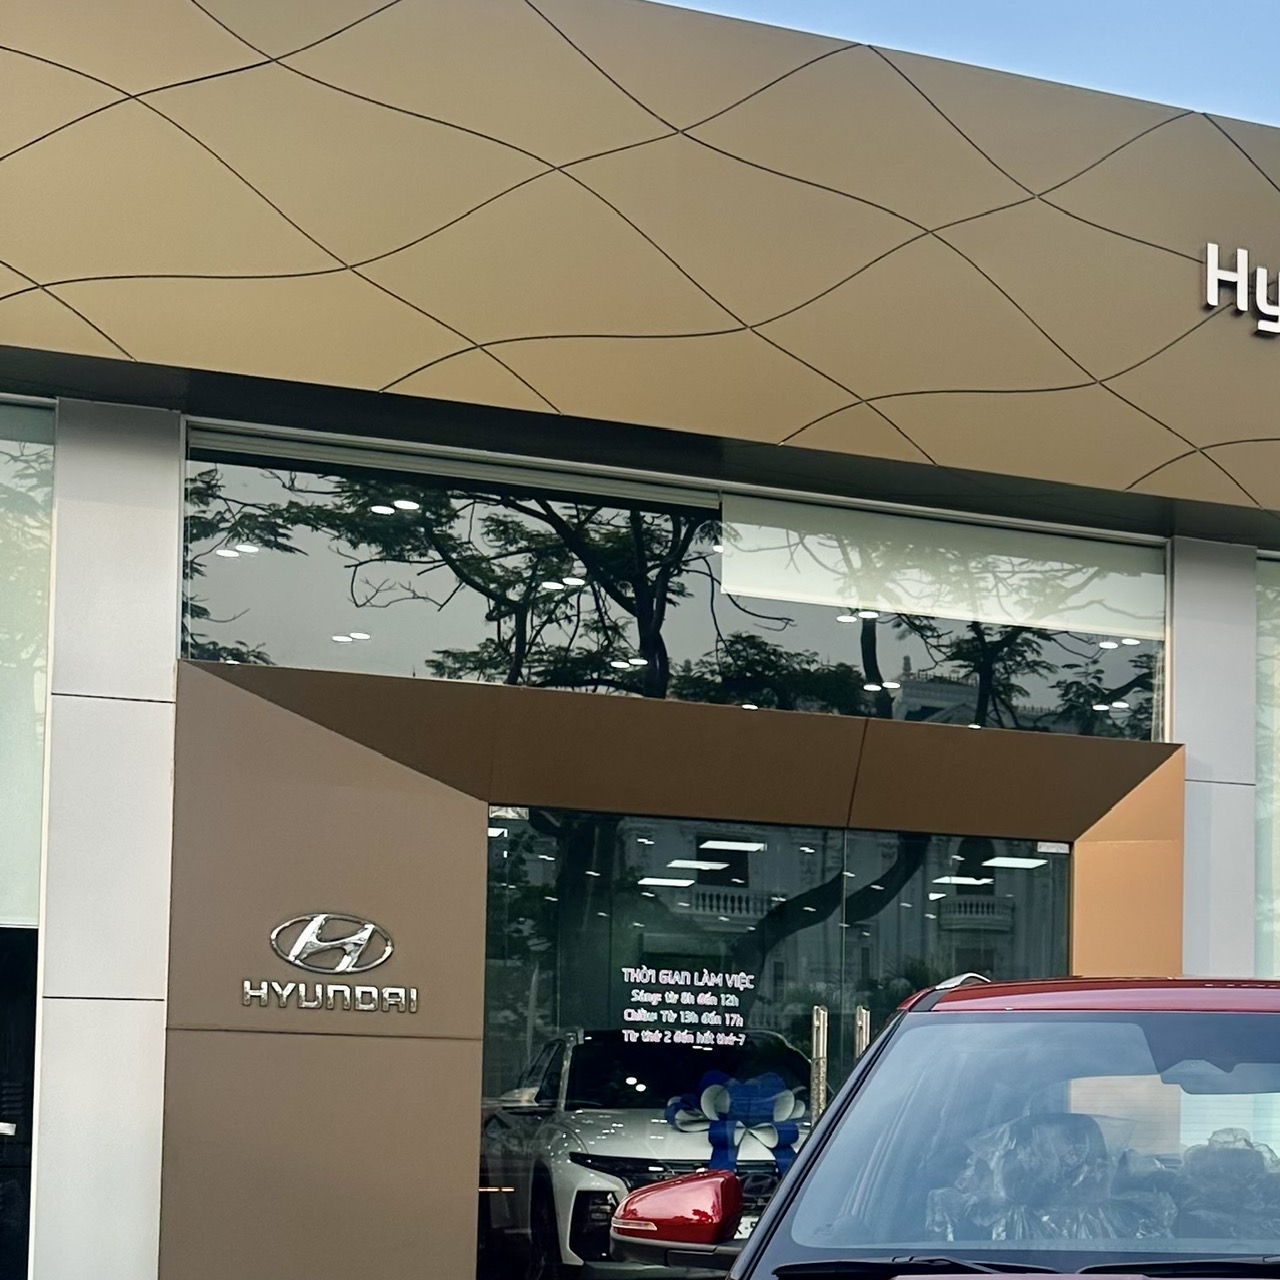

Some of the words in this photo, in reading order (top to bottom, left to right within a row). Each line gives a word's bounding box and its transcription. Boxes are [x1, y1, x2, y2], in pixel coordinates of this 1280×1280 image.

[658, 969, 690, 986] GIAN
[694, 968, 723, 987] LÀM
[725, 972, 755, 991] VIỆC
[242, 980, 418, 1013] HYUNDAI
[720, 993, 740, 1007] 12h
[725, 1012, 744, 1027] 17h
[663, 1030, 672, 1043] 2
